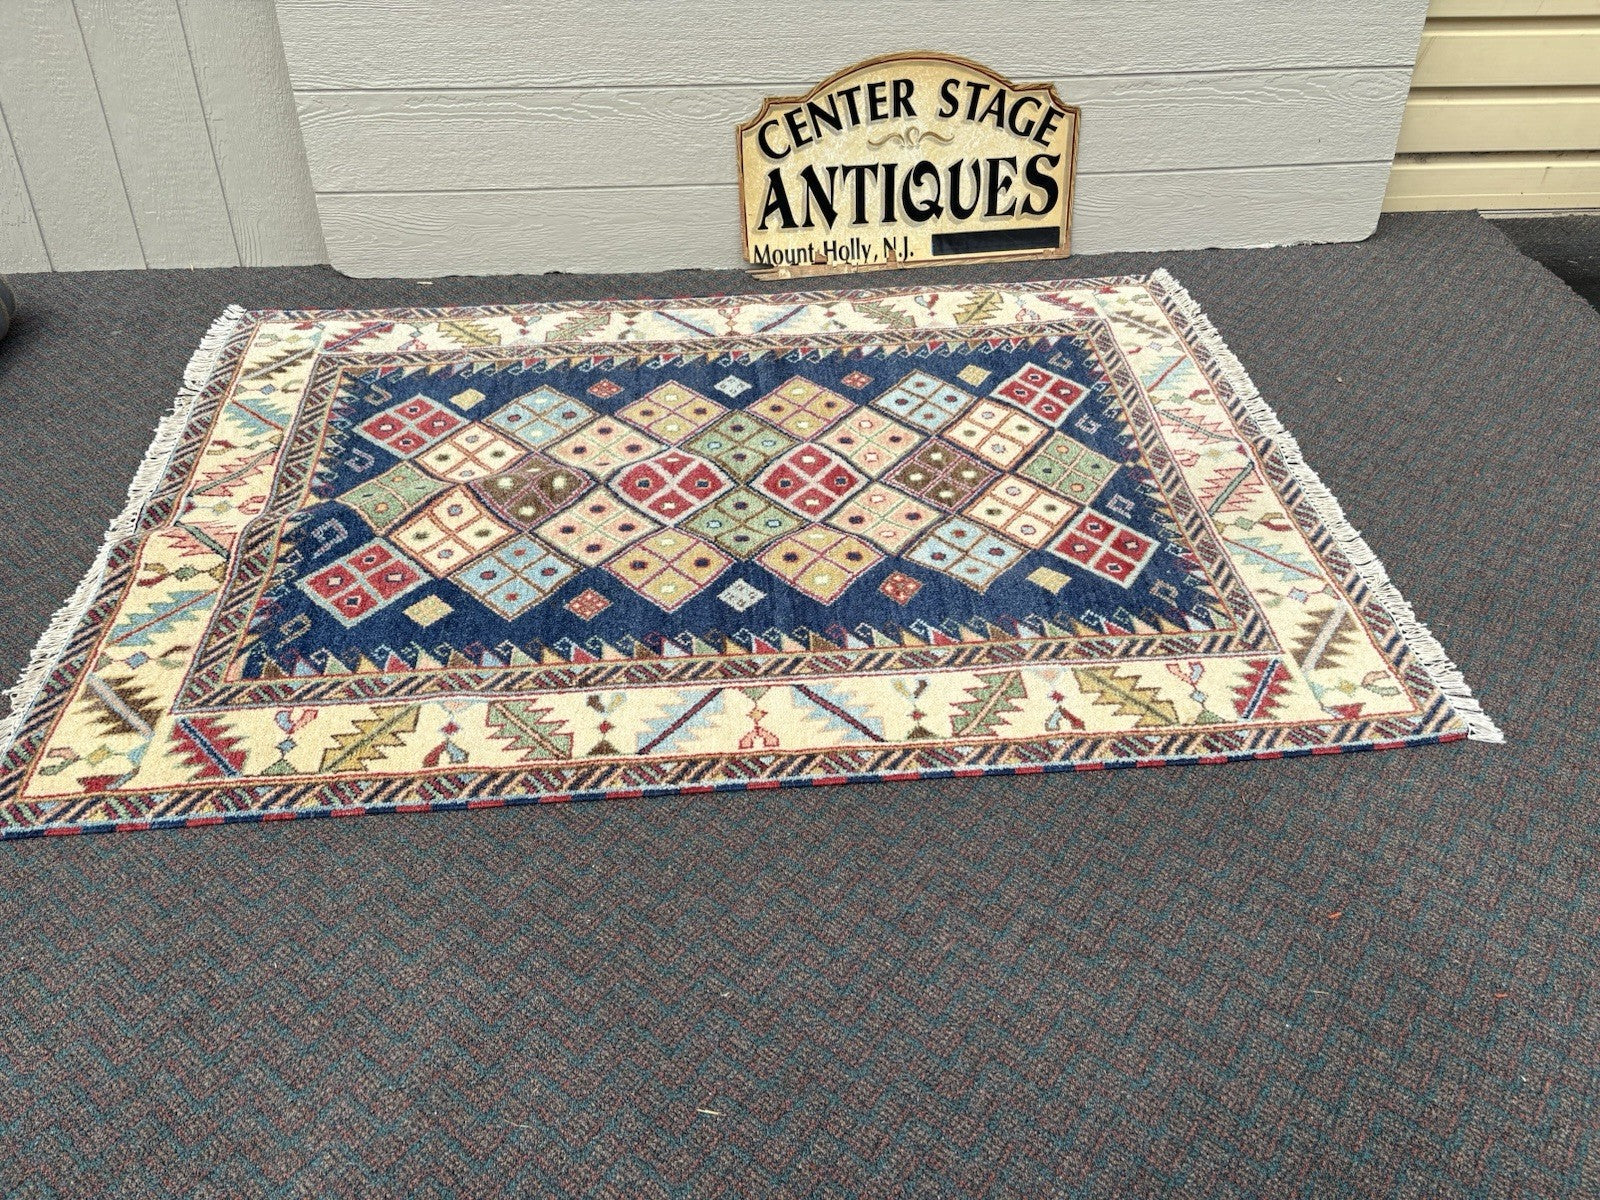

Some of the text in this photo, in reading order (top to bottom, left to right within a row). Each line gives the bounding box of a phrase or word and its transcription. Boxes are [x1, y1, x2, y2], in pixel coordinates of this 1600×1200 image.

[757, 78, 1065, 159] CENTER STAGE
[757, 153, 1062, 230] ANTIQUES
[754, 242, 814, 265] Mount
[884, 237, 914, 261] N.J.
